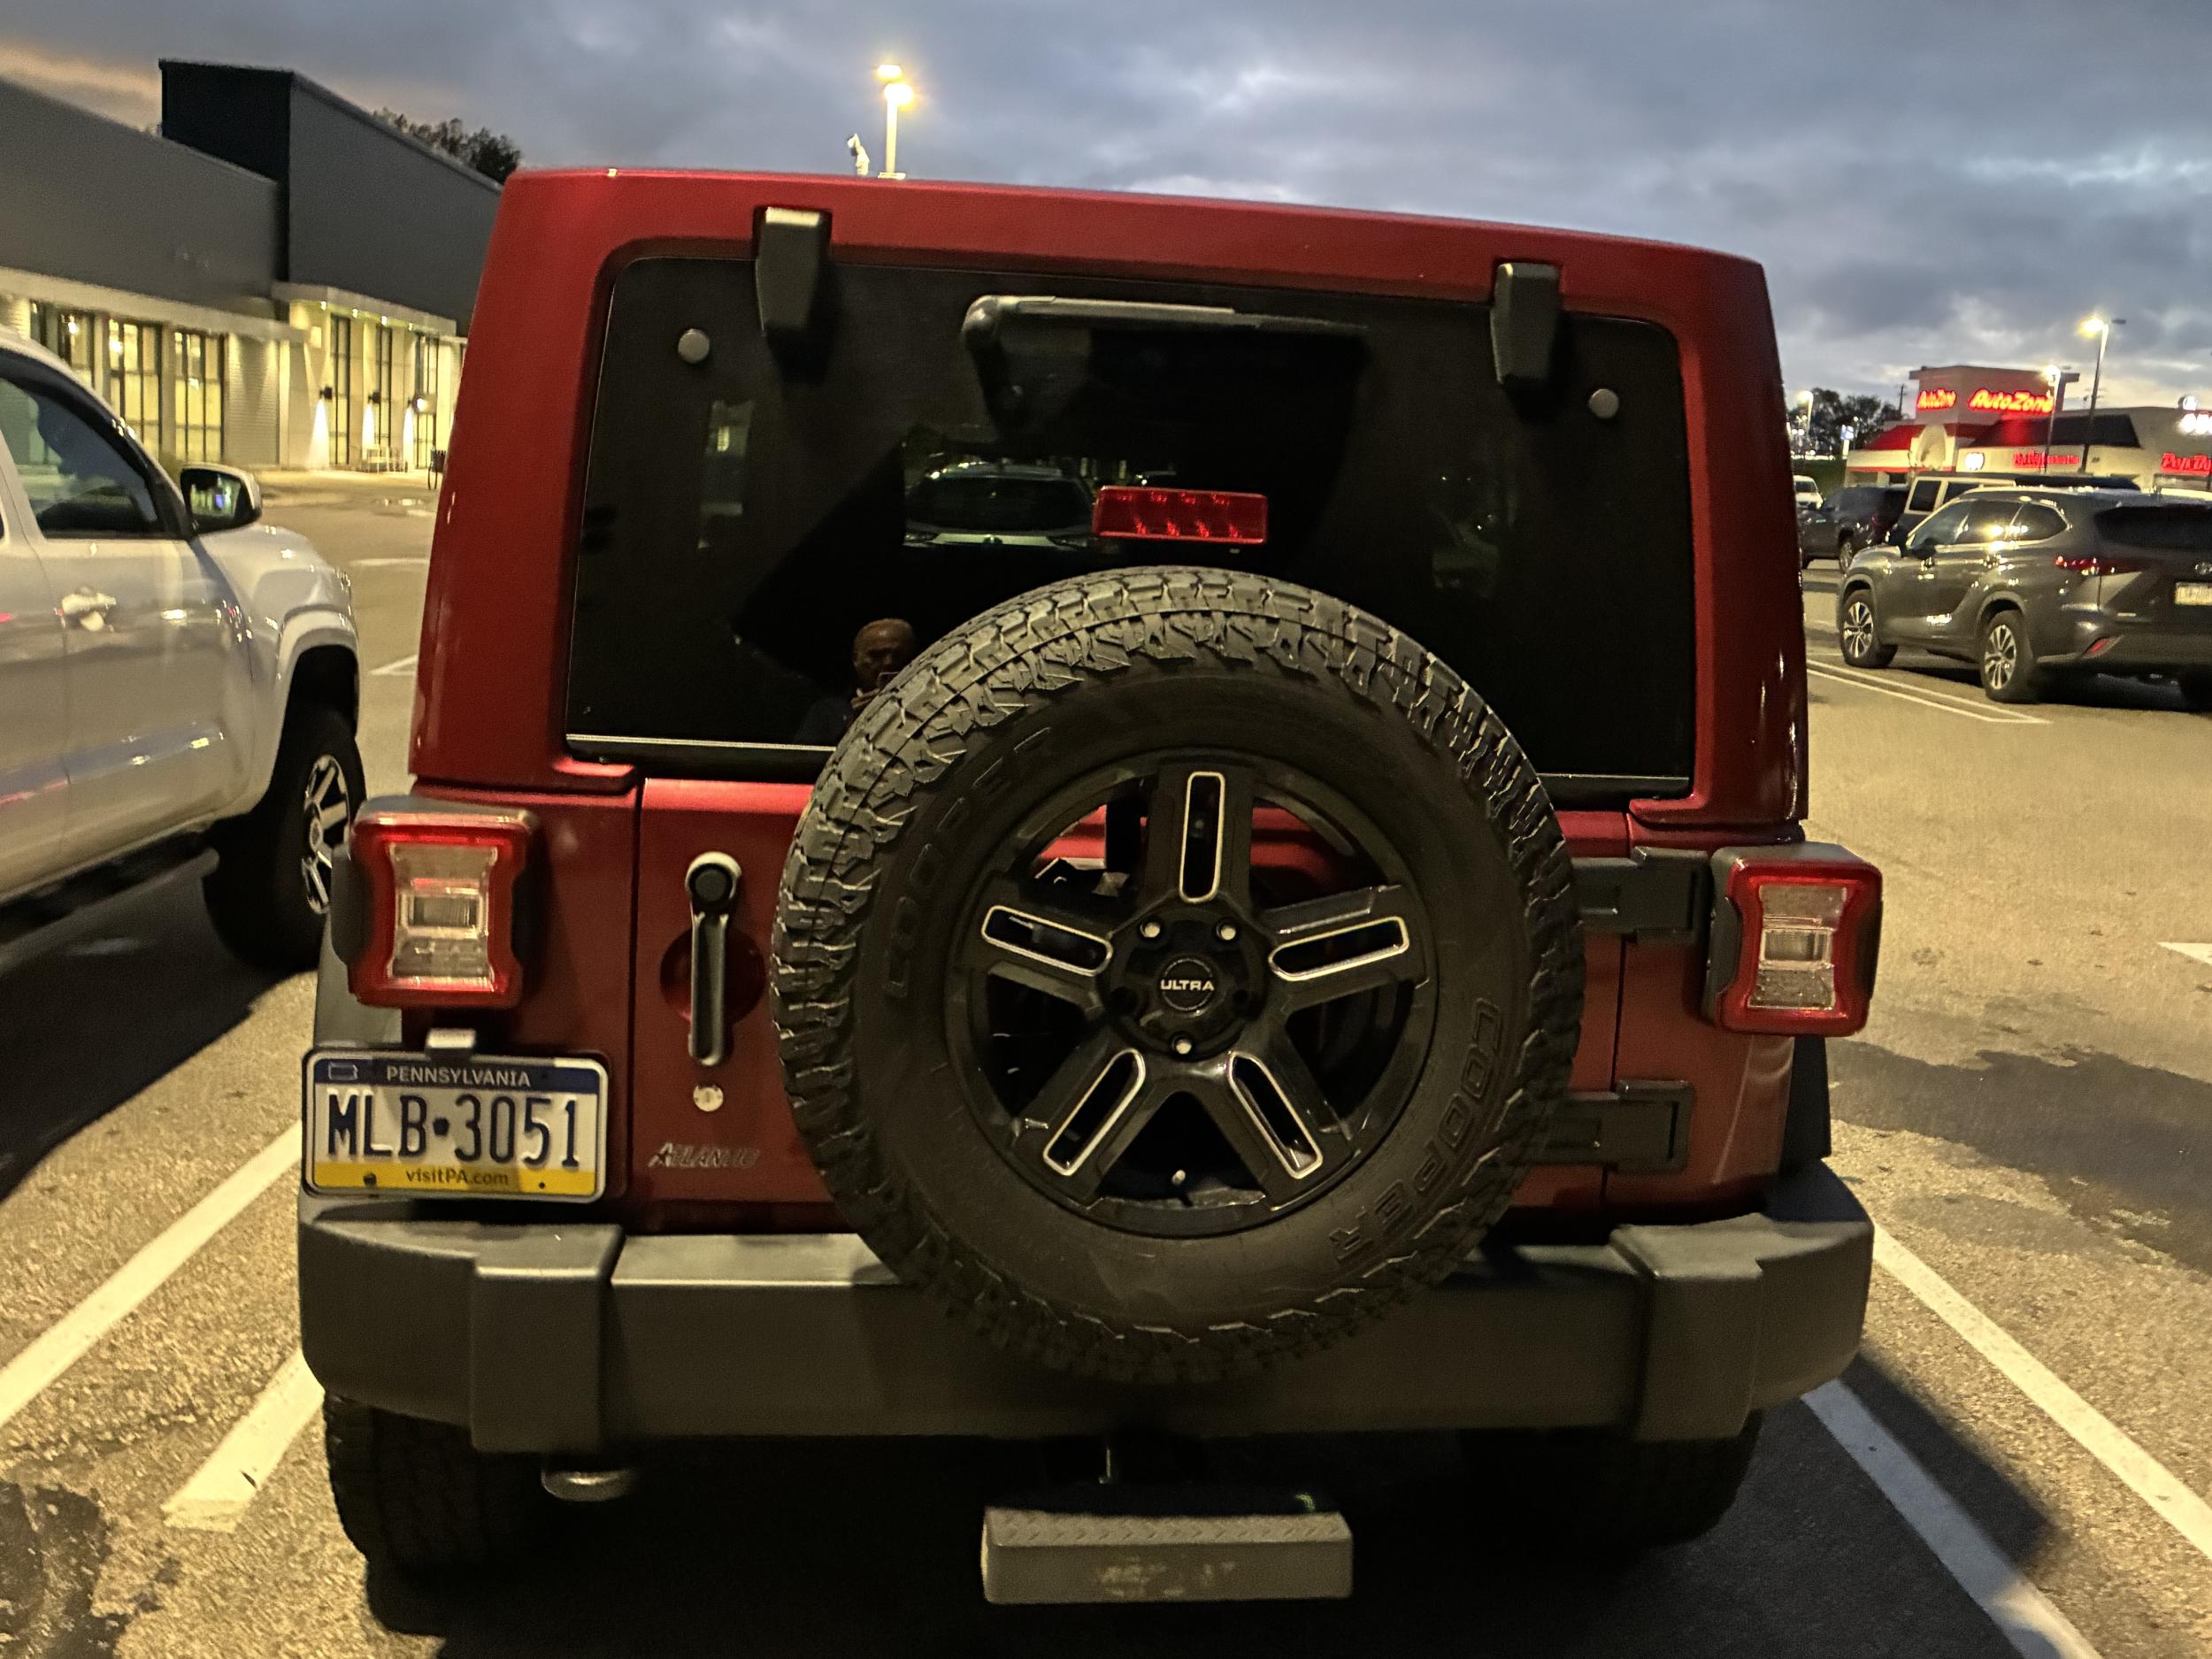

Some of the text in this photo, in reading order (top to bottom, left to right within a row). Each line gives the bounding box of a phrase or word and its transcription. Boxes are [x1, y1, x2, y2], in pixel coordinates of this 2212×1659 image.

[1969, 388, 2055, 414] AutoZone
[1160, 979, 1215, 991] ULTRA
[386, 1064, 531, 1087] PENNSYLVANIA
[1328, 996, 1503, 1263] COOPER
[405, 1165, 510, 1186] visitPA.com
